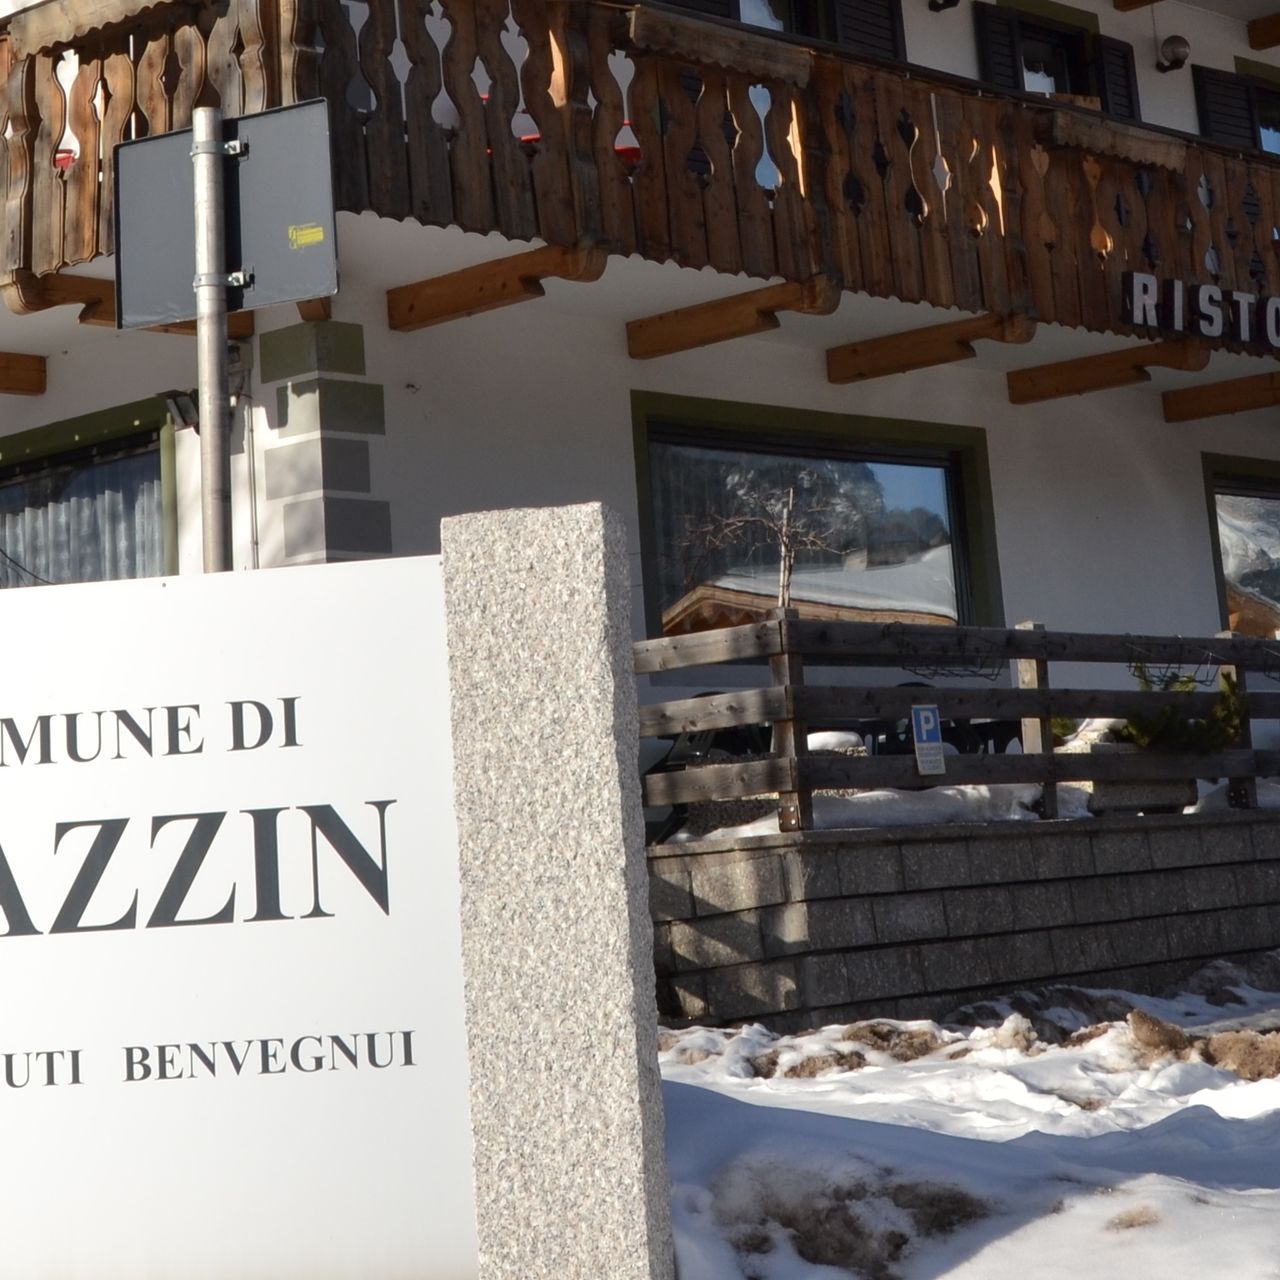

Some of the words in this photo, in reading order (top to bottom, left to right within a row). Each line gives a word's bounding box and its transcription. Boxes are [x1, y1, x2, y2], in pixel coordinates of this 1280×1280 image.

[228, 695, 303, 751] DI
[920, 710, 935, 741] P
[124, 1030, 417, 1082] BENVEGNUI
